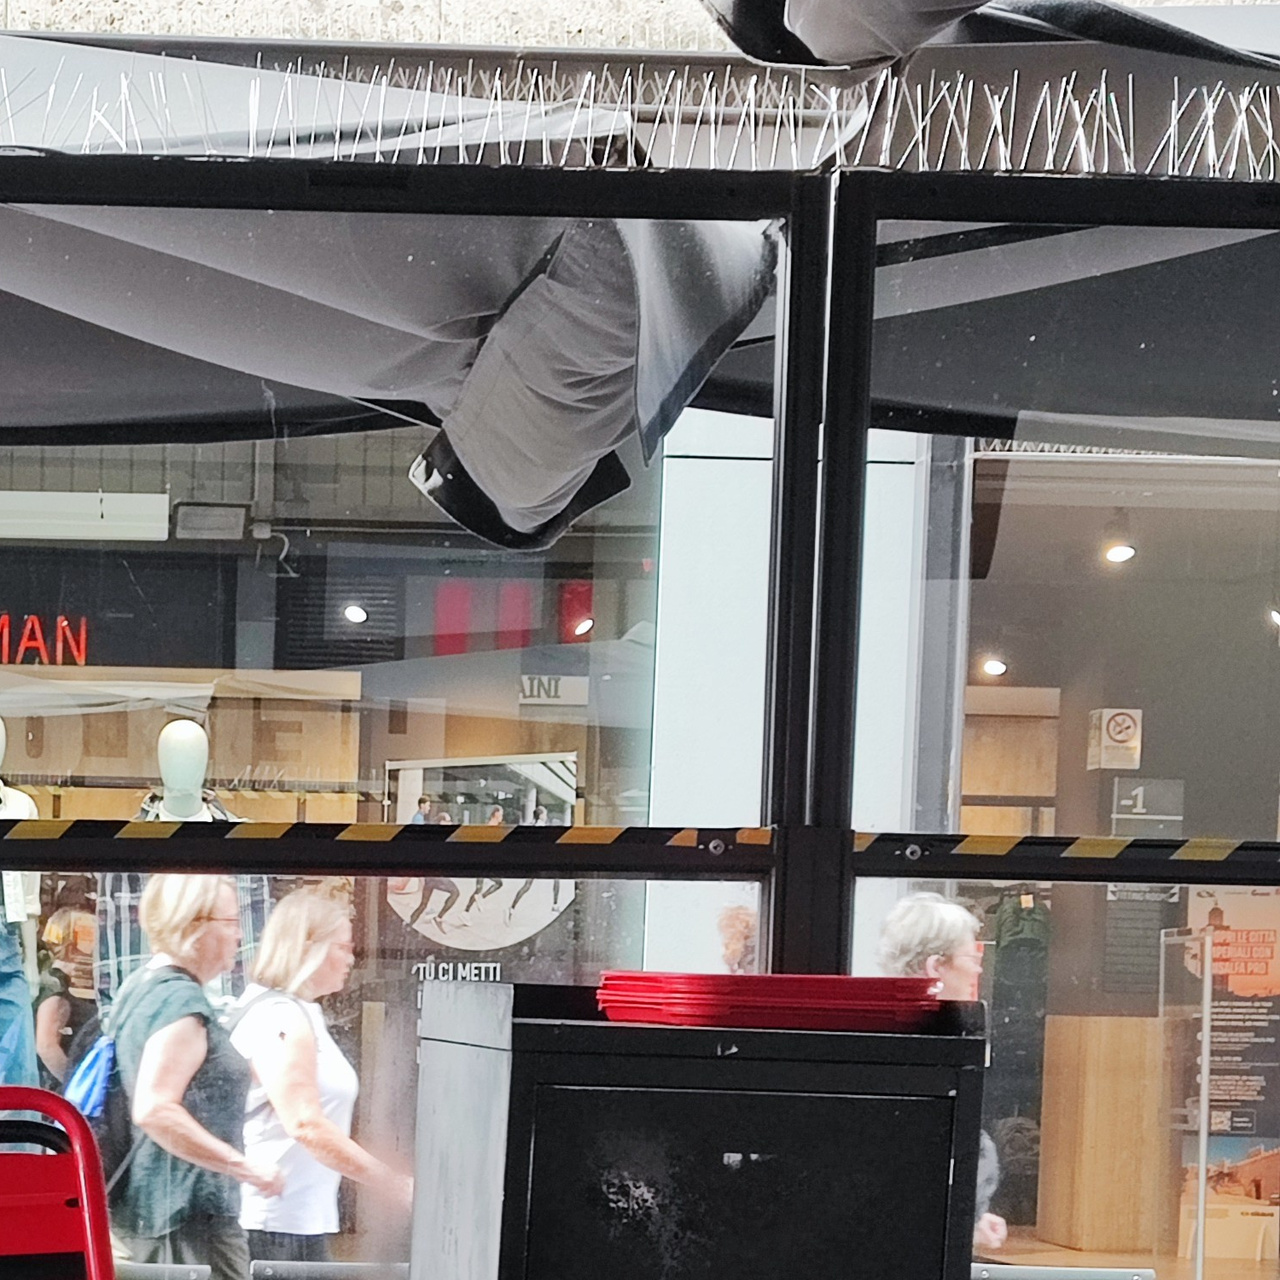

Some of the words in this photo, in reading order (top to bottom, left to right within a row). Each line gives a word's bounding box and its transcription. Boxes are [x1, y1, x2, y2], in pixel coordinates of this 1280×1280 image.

[1120, 786, 1147, 813] -1
[417, 962, 435, 981] TU
[439, 962, 454, 981] CI
[458, 962, 501, 981] METTI
